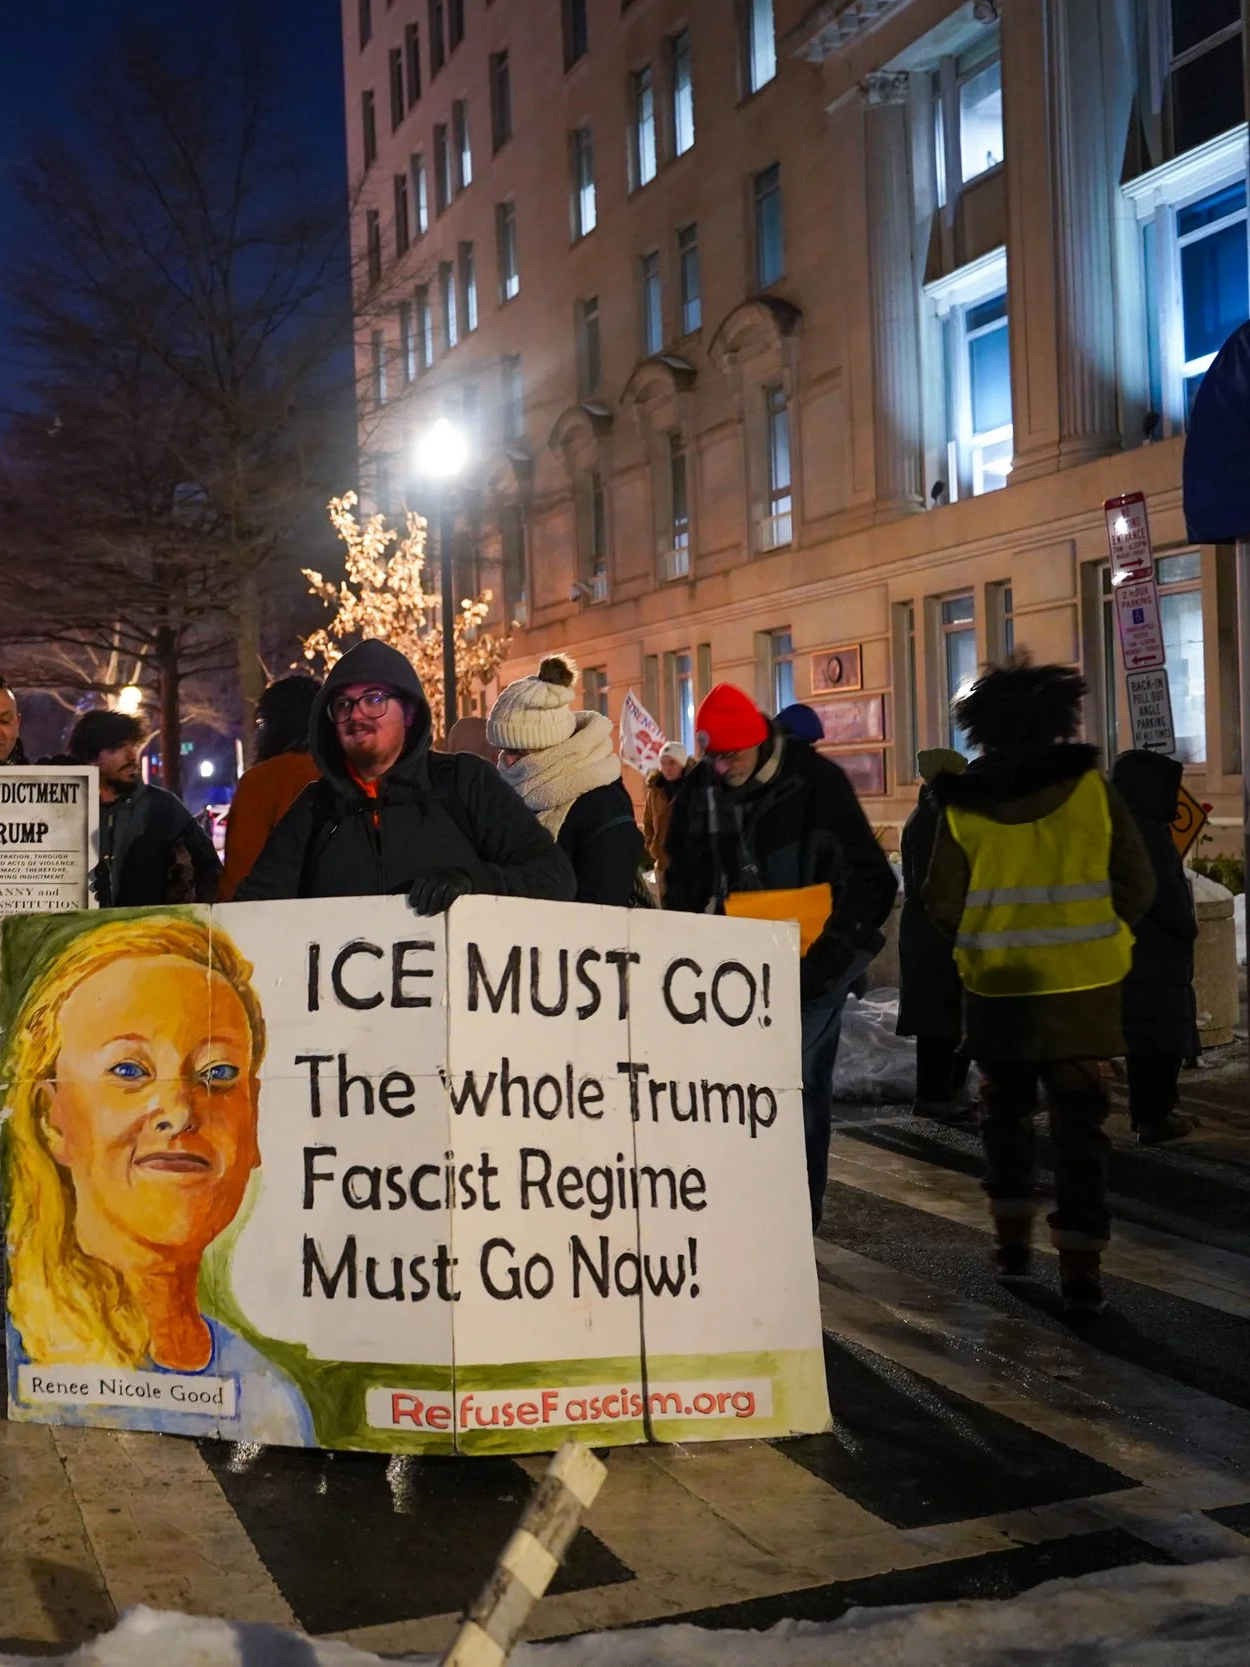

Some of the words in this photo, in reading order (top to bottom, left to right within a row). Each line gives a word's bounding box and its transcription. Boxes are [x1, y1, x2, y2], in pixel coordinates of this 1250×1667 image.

[1131, 677, 1163, 693] BACK-IN
[1137, 716, 1166, 730] PARKING
[1140, 703, 1161, 717] ANGLE
[37, 888, 60, 897] and
[306, 939, 436, 1011] ICE
[466, 941, 641, 1021] MUST
[661, 956, 773, 1029] GO!
[294, 1052, 415, 1119] The
[438, 1056, 606, 1122] whole
[616, 1062, 779, 1139] Trump
[302, 1144, 501, 1212] Fascist
[519, 1146, 708, 1220] Regime
[302, 1233, 461, 1302] Must
[480, 1236, 555, 1300] Go
[569, 1234, 702, 1299] Now!
[31, 1376, 90, 1397] Renee
[98, 1379, 162, 1400] Nicole
[170, 1384, 224, 1406] Good
[391, 1388, 756, 1429] RefuseFascism.org
